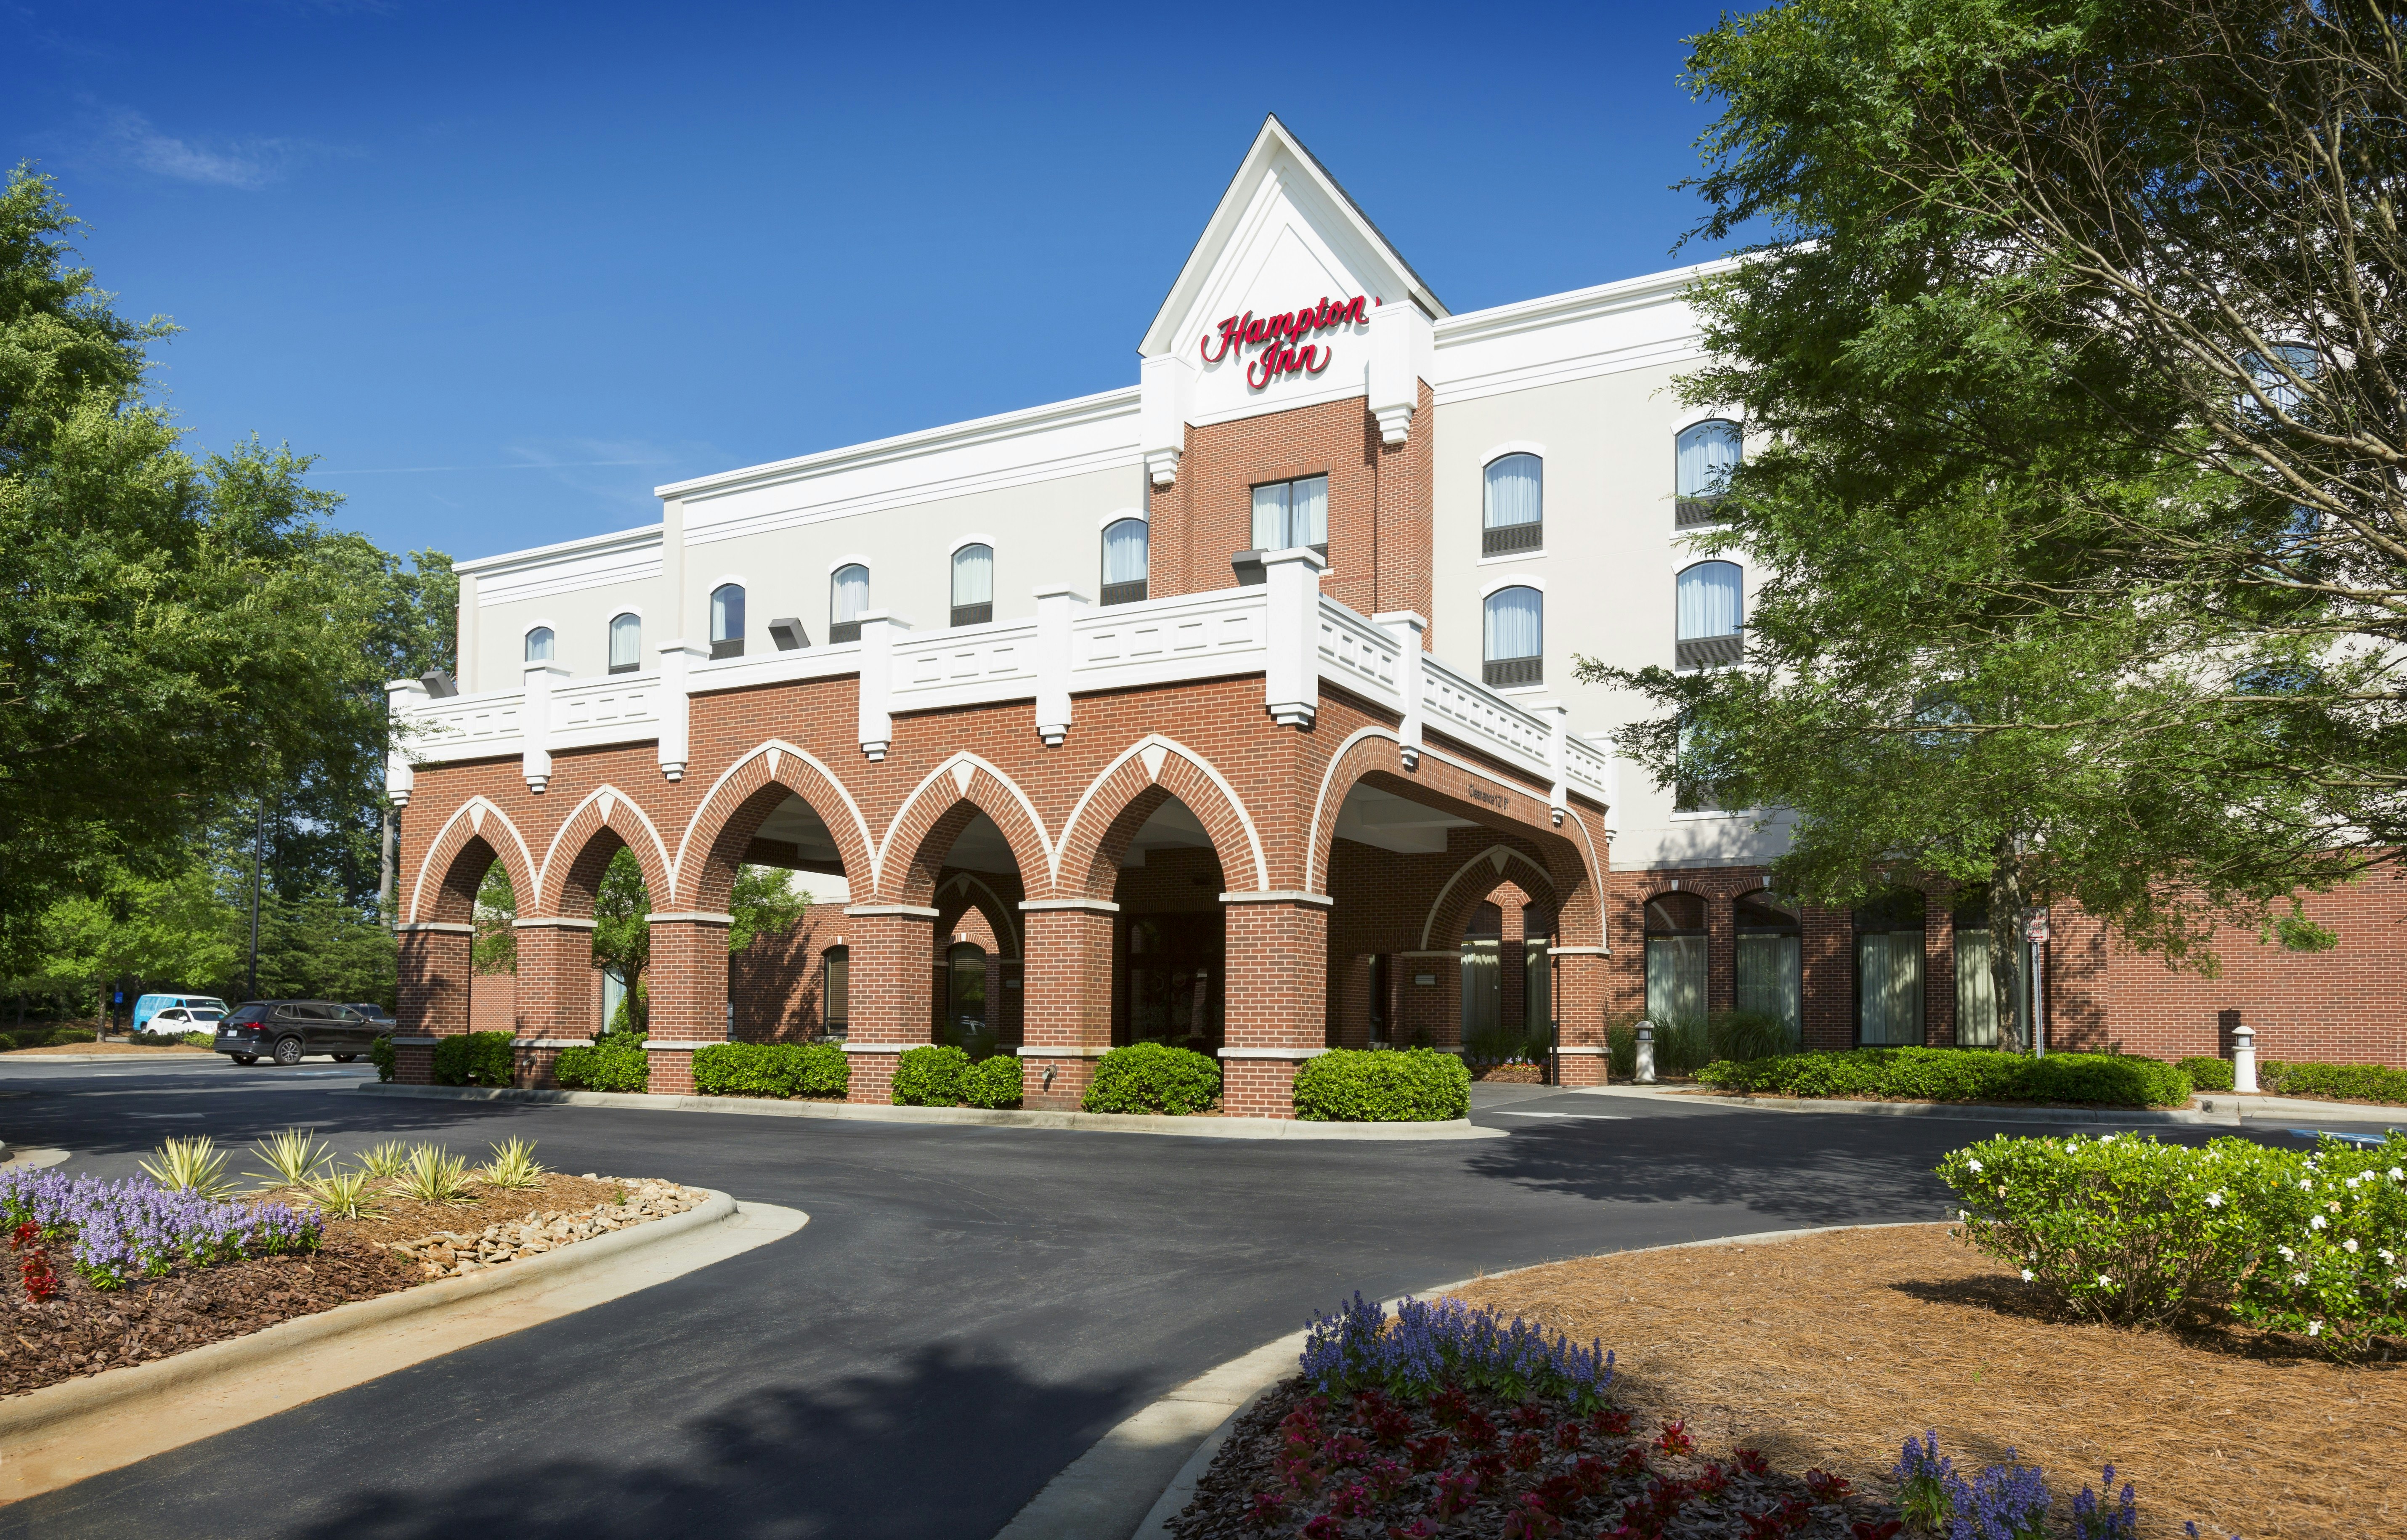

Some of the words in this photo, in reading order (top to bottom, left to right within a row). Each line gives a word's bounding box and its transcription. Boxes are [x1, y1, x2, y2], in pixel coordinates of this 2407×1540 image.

[1201, 295, 1382, 363] Hampton
[1247, 340, 1332, 390] Inn
[1469, 784, 1494, 805] Clearance
